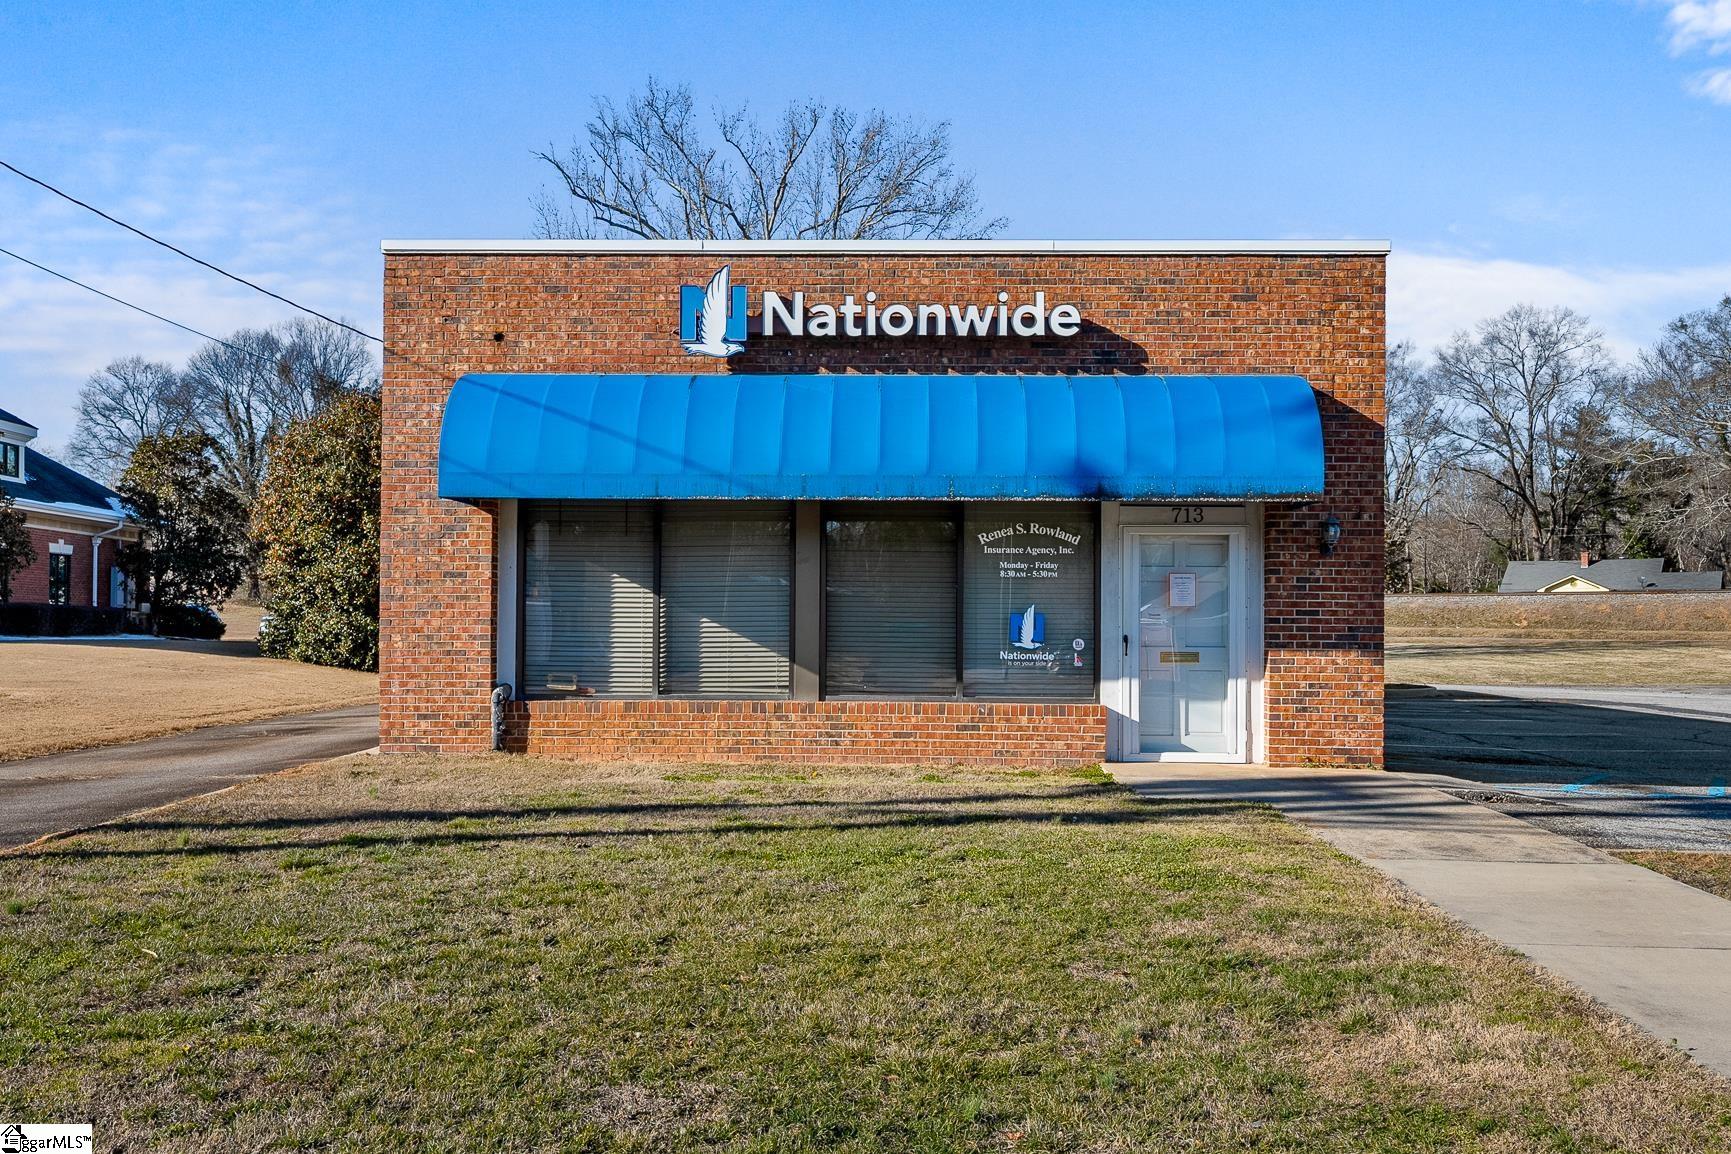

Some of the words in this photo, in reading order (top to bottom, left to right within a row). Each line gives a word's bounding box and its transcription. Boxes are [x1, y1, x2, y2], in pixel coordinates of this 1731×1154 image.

[761, 291, 1082, 337] Nationwide
[1171, 507, 1204, 523] 713
[977, 527, 1014, 545] Renea
[1015, 522, 1027, 534] S.
[1029, 522, 1081, 545] Rowland
[984, 545, 1024, 554] Insurance
[1025, 546, 1057, 556] Agency,
[1059, 546, 1074, 554] Inc.
[1000, 562, 1029, 570] Monday
[1035, 562, 1058, 570] Friday
